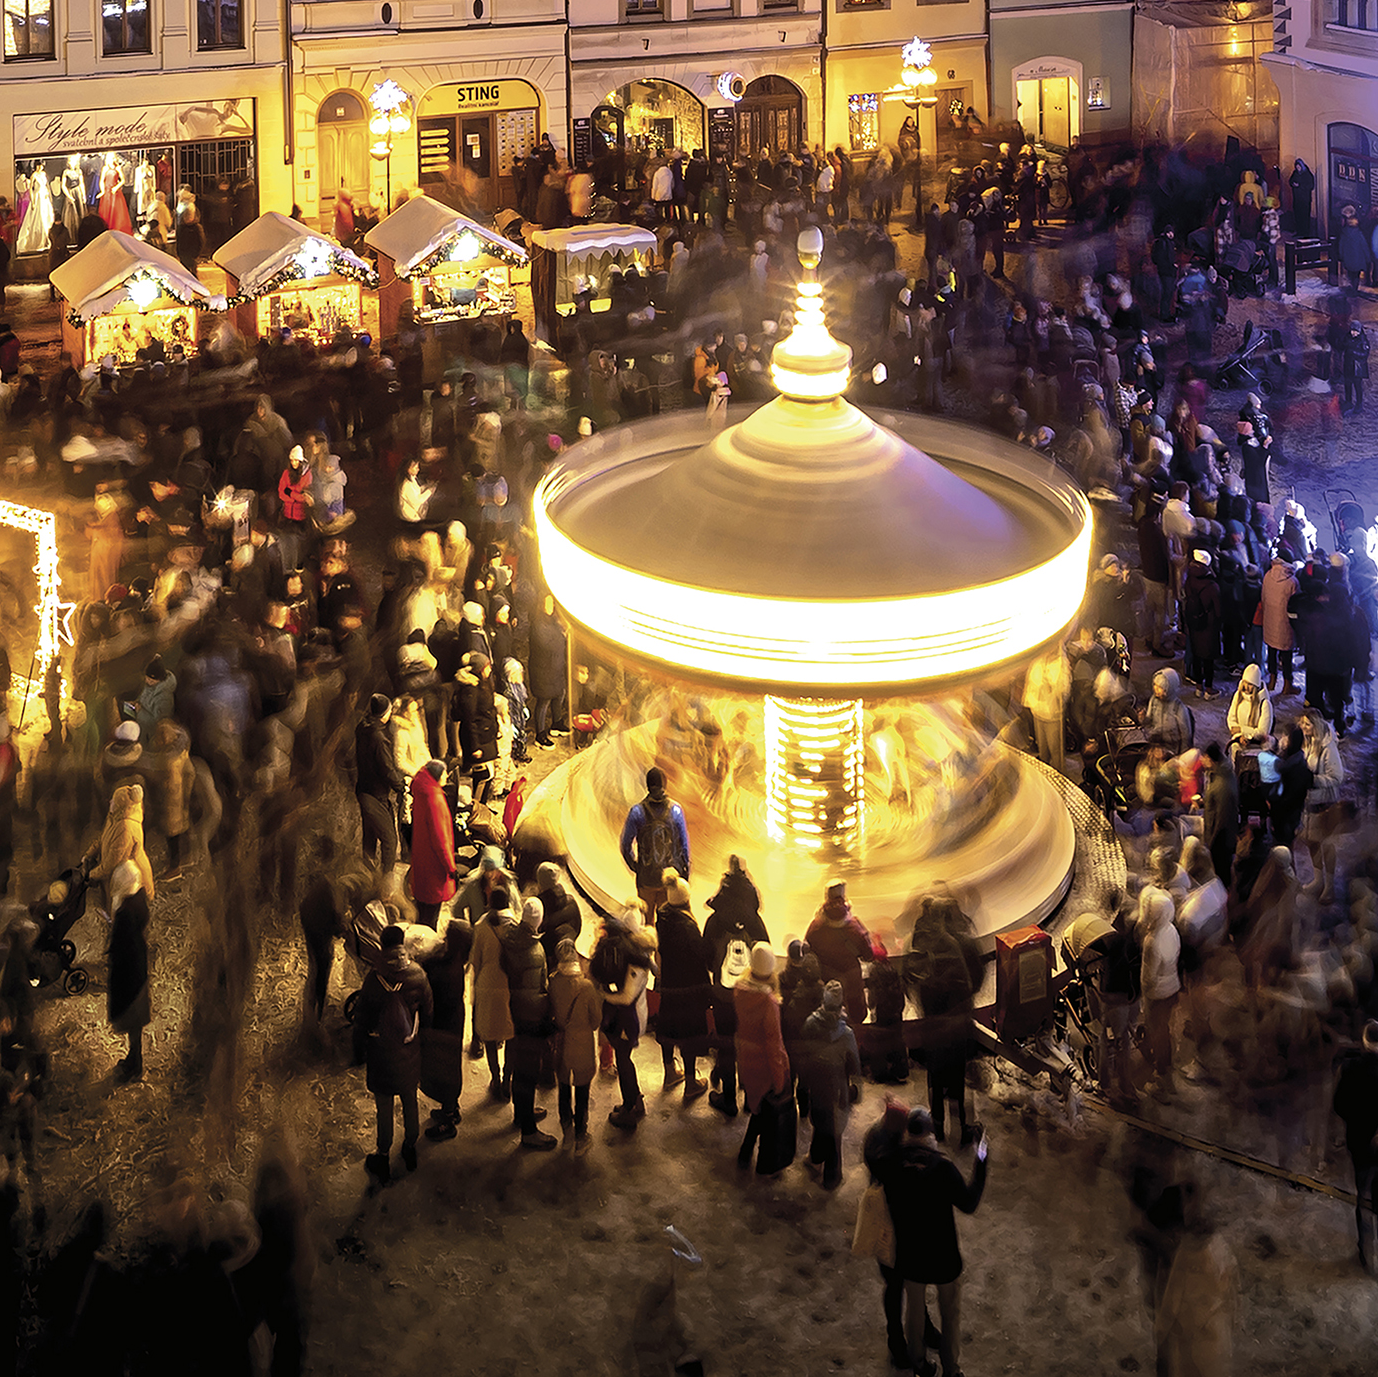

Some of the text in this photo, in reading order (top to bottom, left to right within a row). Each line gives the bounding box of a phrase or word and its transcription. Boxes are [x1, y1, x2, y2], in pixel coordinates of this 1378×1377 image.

[457, 85, 499, 102] STING
[25, 111, 148, 151] Style mode
